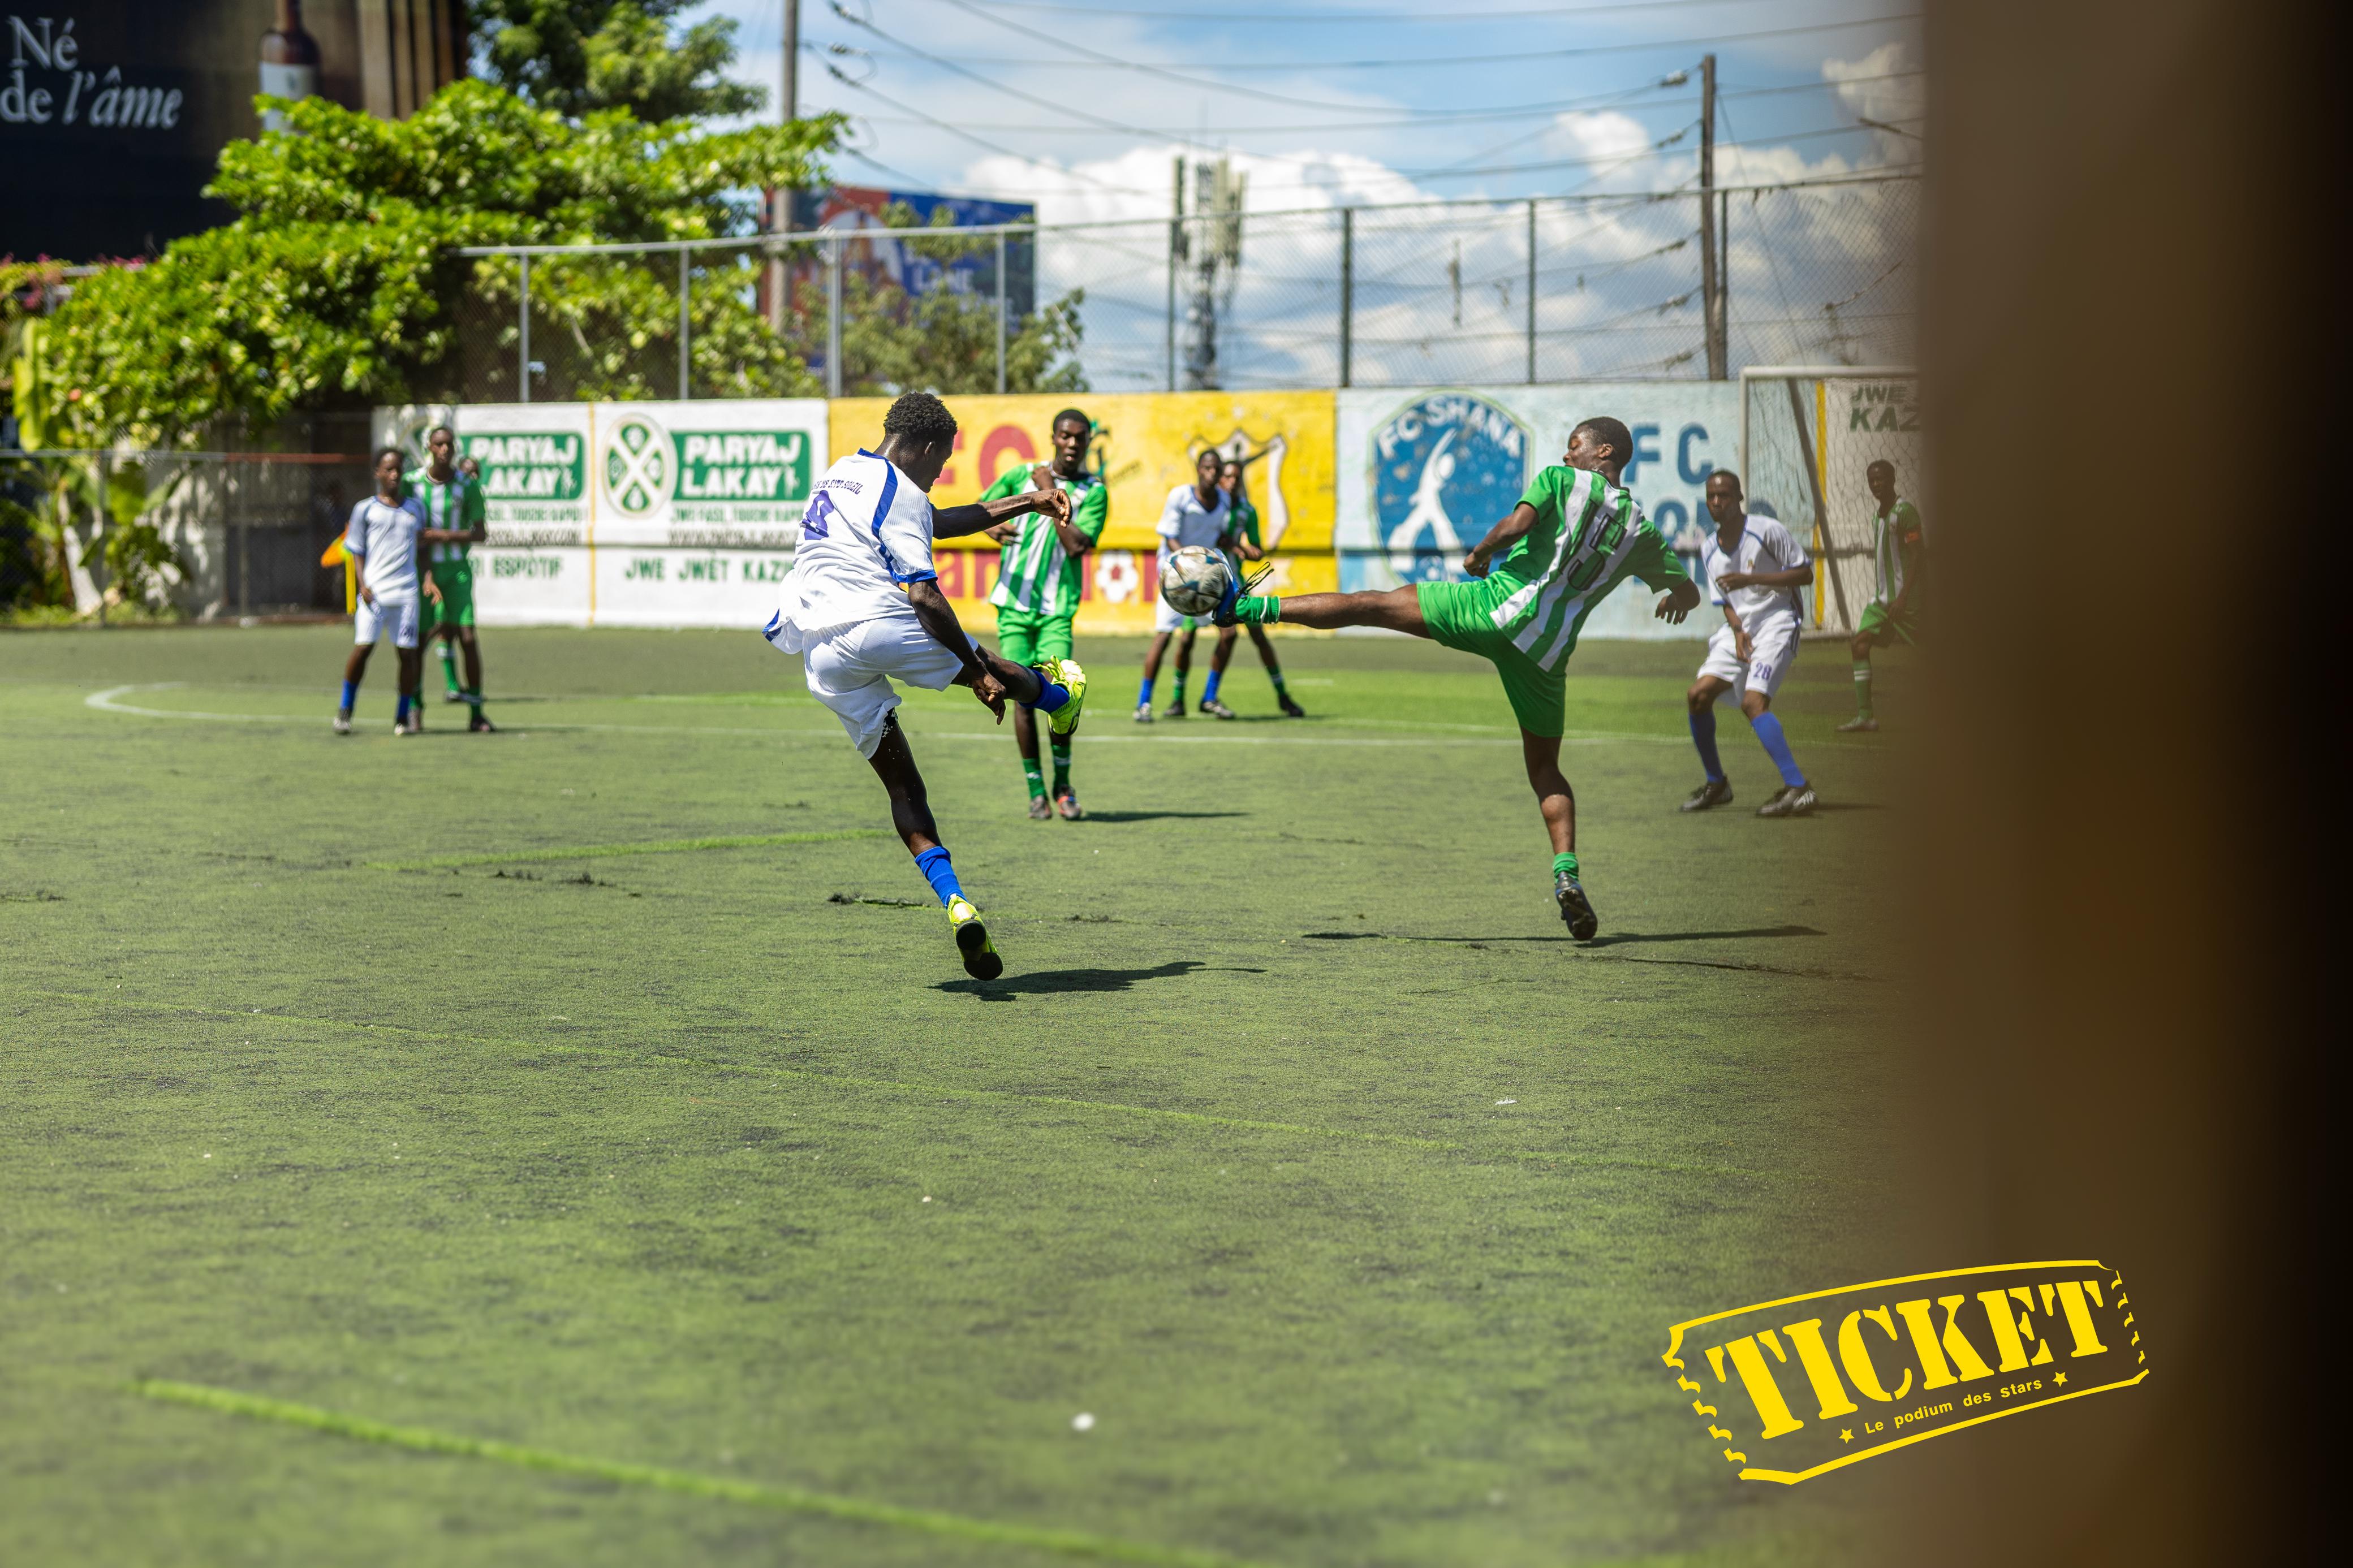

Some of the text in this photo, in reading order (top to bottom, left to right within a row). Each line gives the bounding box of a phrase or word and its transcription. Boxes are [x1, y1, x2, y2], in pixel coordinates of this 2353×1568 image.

[6, 15, 78, 71] Né
[0, 68, 53, 124] de
[1378, 396, 1522, 459] FC SHANA
[468, 435, 579, 466] PARYAJ
[684, 433, 802, 466] PARYAJ
[481, 465, 562, 498] AKAY
[1558, 499, 1628, 591] 15
[625, 557, 665, 581] JWE
[1753, 662, 1773, 680] 28
